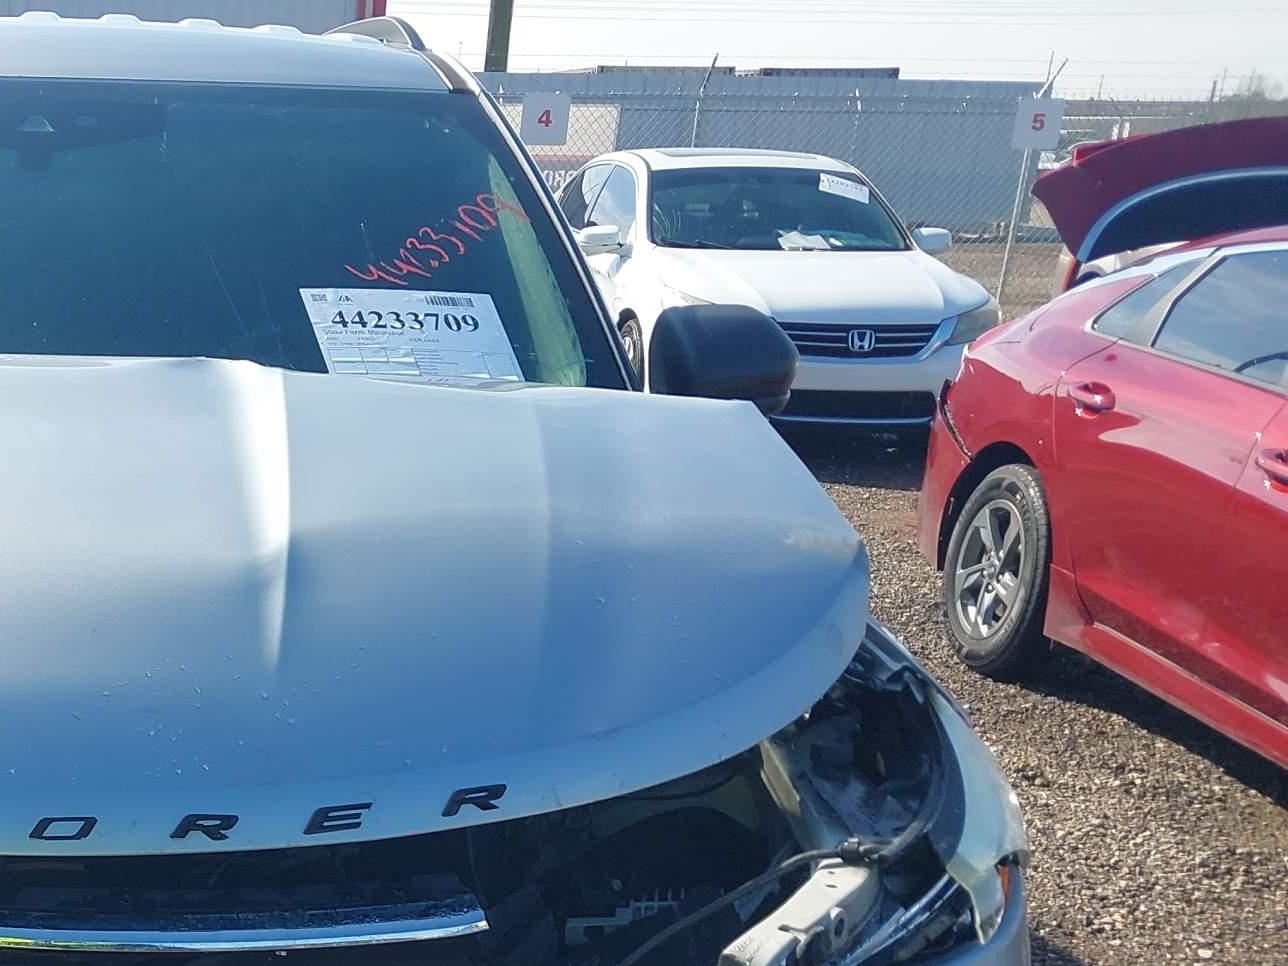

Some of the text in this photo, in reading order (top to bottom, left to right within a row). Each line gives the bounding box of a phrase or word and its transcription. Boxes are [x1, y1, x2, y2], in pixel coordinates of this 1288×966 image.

[537, 109, 552, 128] 4
[1030, 113, 1045, 132] 5
[331, 310, 480, 333] 44233709
